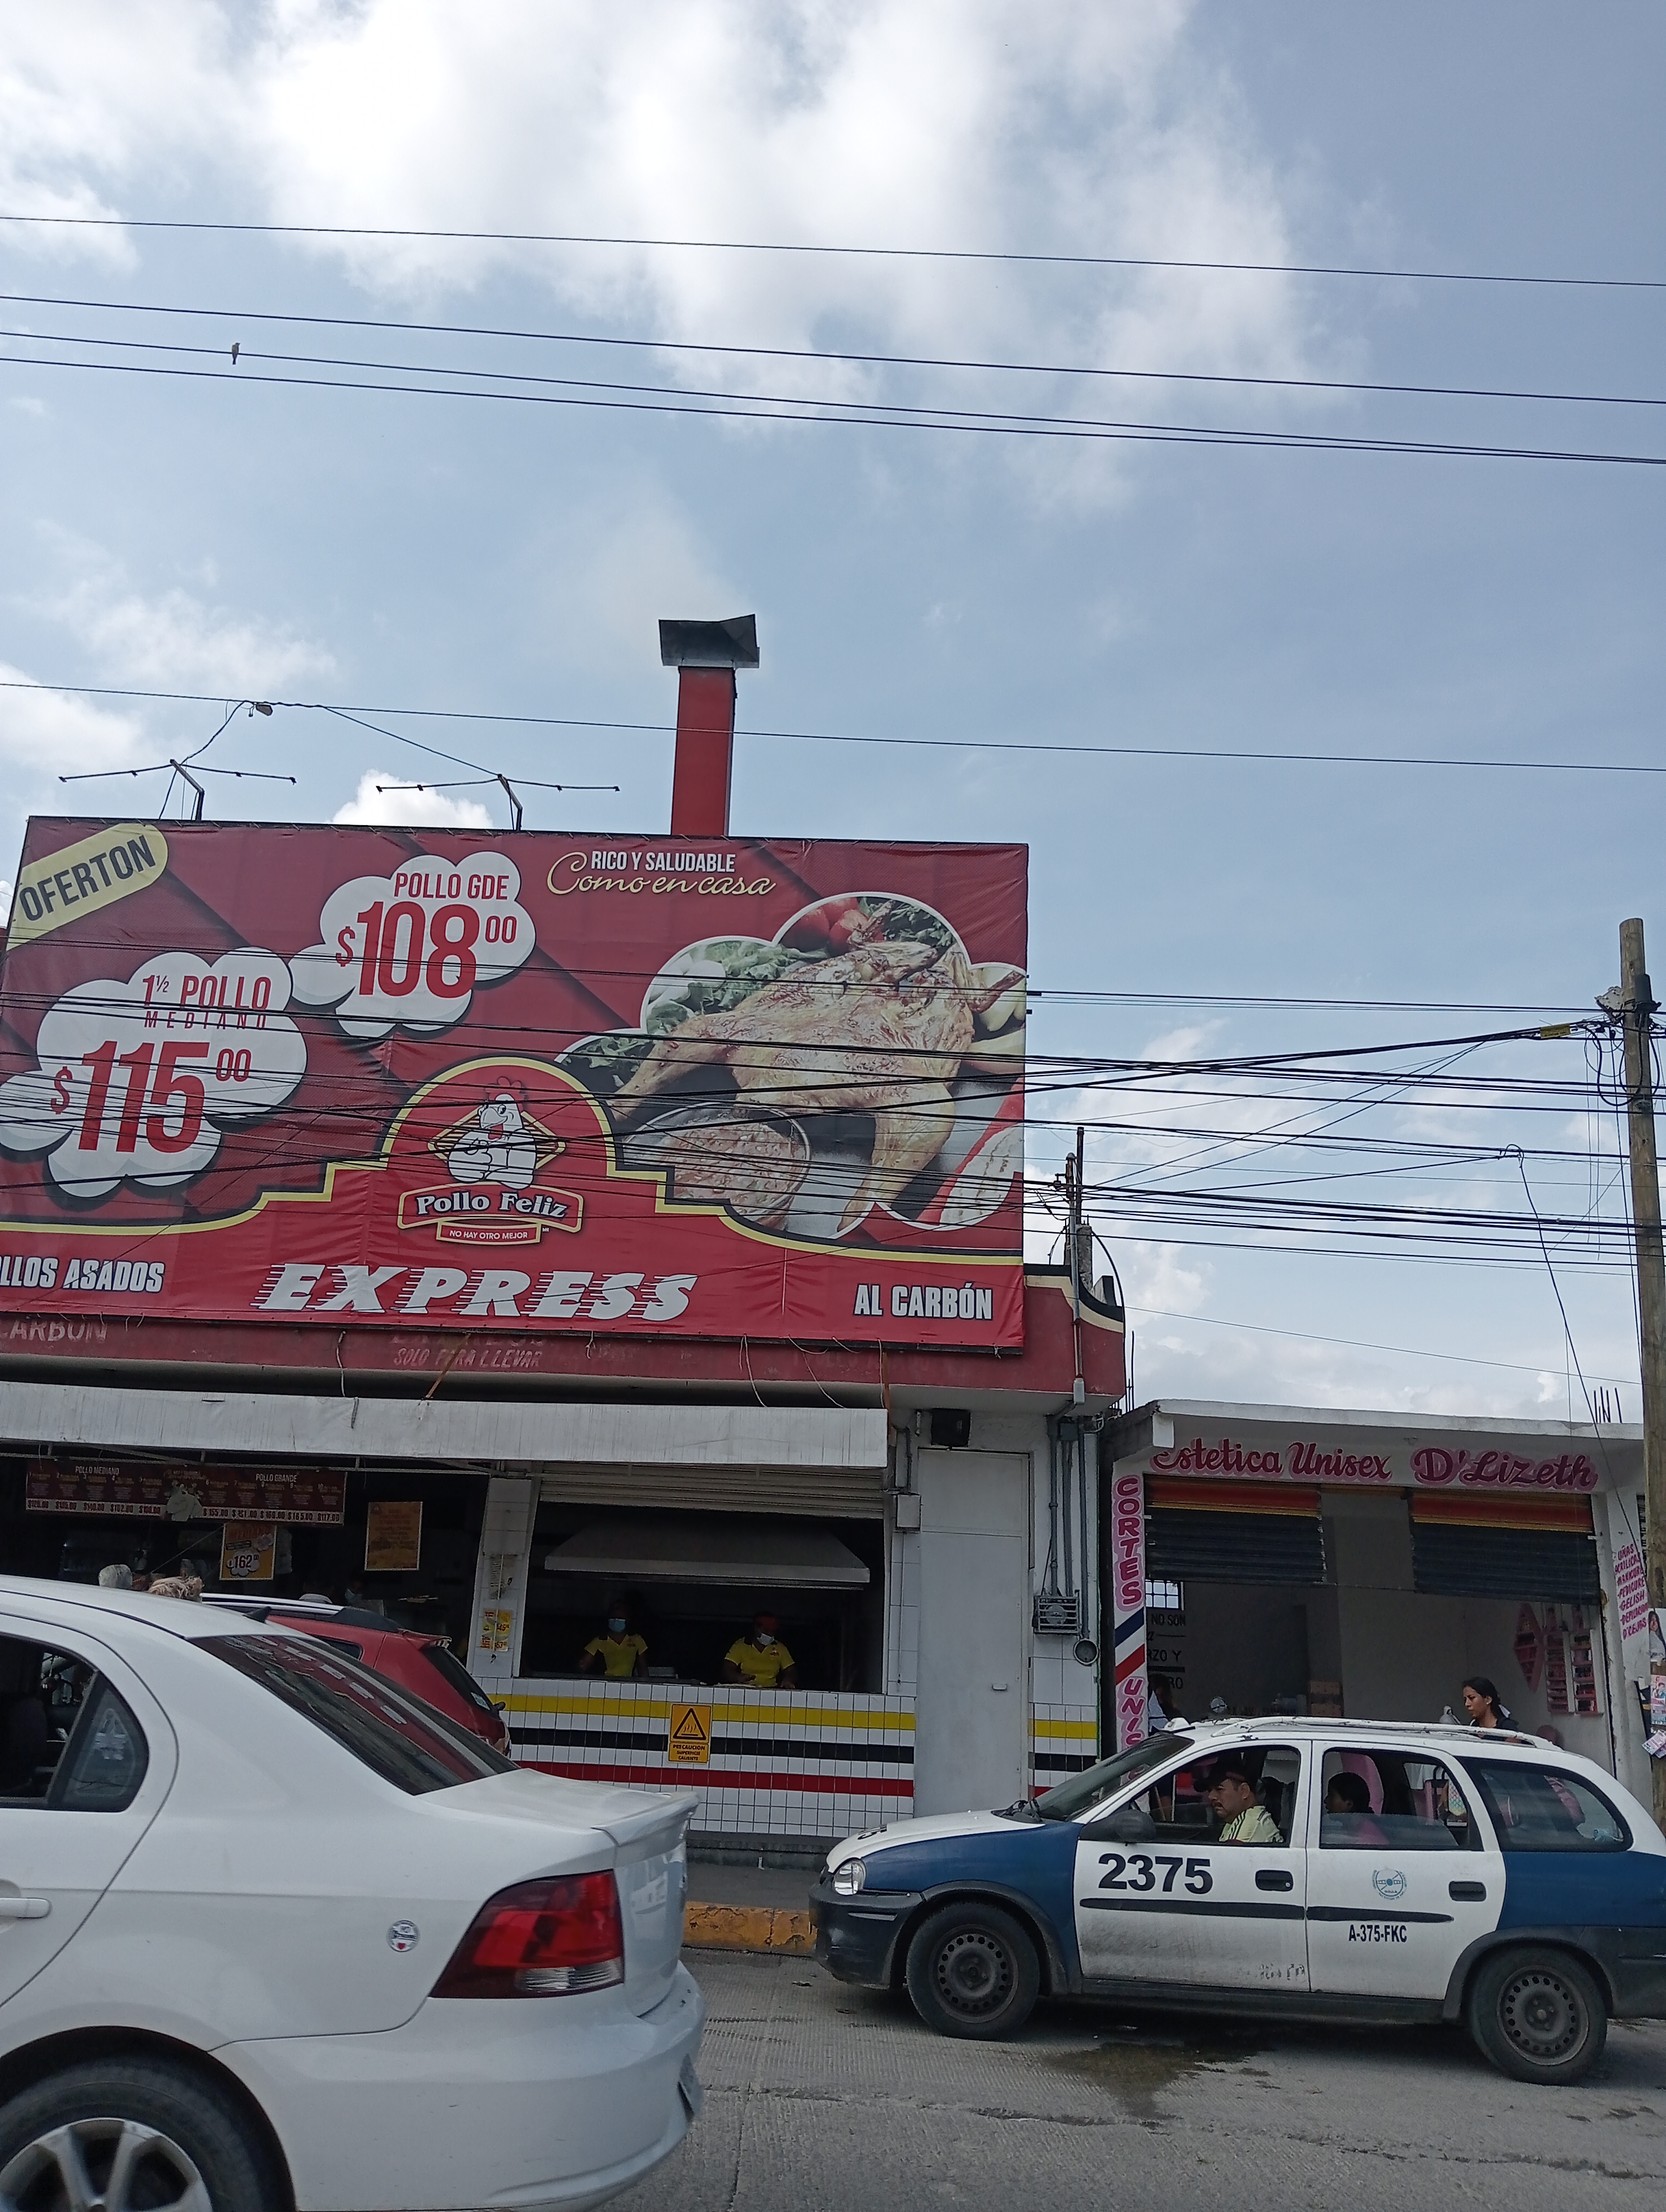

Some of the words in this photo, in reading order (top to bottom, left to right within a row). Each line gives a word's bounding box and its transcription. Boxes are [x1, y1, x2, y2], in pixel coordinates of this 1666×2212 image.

[19, 834, 156, 922] OFERTON
[547, 852, 650, 895] Como
[651, 877, 697, 894] en
[696, 877, 777, 897] casa
[591, 850, 628, 871] RICO
[631, 851, 643, 871] Y
[645, 852, 736, 873] SALUDABLE
[394, 872, 460, 899] POLLO
[467, 873, 509, 901] GDE
[180, 975, 272, 1010] POLLO
[144, 1011, 267, 1030] MEDIANO
[416, 1190, 490, 1216] Pollo
[499, 1191, 567, 1219] Feliz
[449, 1230, 461, 1238] NO
[463, 1230, 478, 1239] HAY
[479, 1231, 501, 1240] OTRO
[503, 1231, 529, 1242] MEJOR
[0, 1256, 59, 1288] LLOS
[61, 1258, 165, 1293] ASADOS
[250, 1262, 698, 1322] EXPRESS
[853, 1283, 883, 1316] AL
[891, 1282, 994, 1321] CARBÓN
[275, 1474, 297, 1482] GRANDE
[1289, 1442, 1392, 1480] Unisex
[1117, 1478, 1142, 1605] CORTES
[1151, 1614, 1164, 1625] NO
[1168, 1615, 1186, 1626] SON
[1098, 1853, 1213, 1895] 2375
[1348, 1924, 1407, 1943] A-375-FKC
